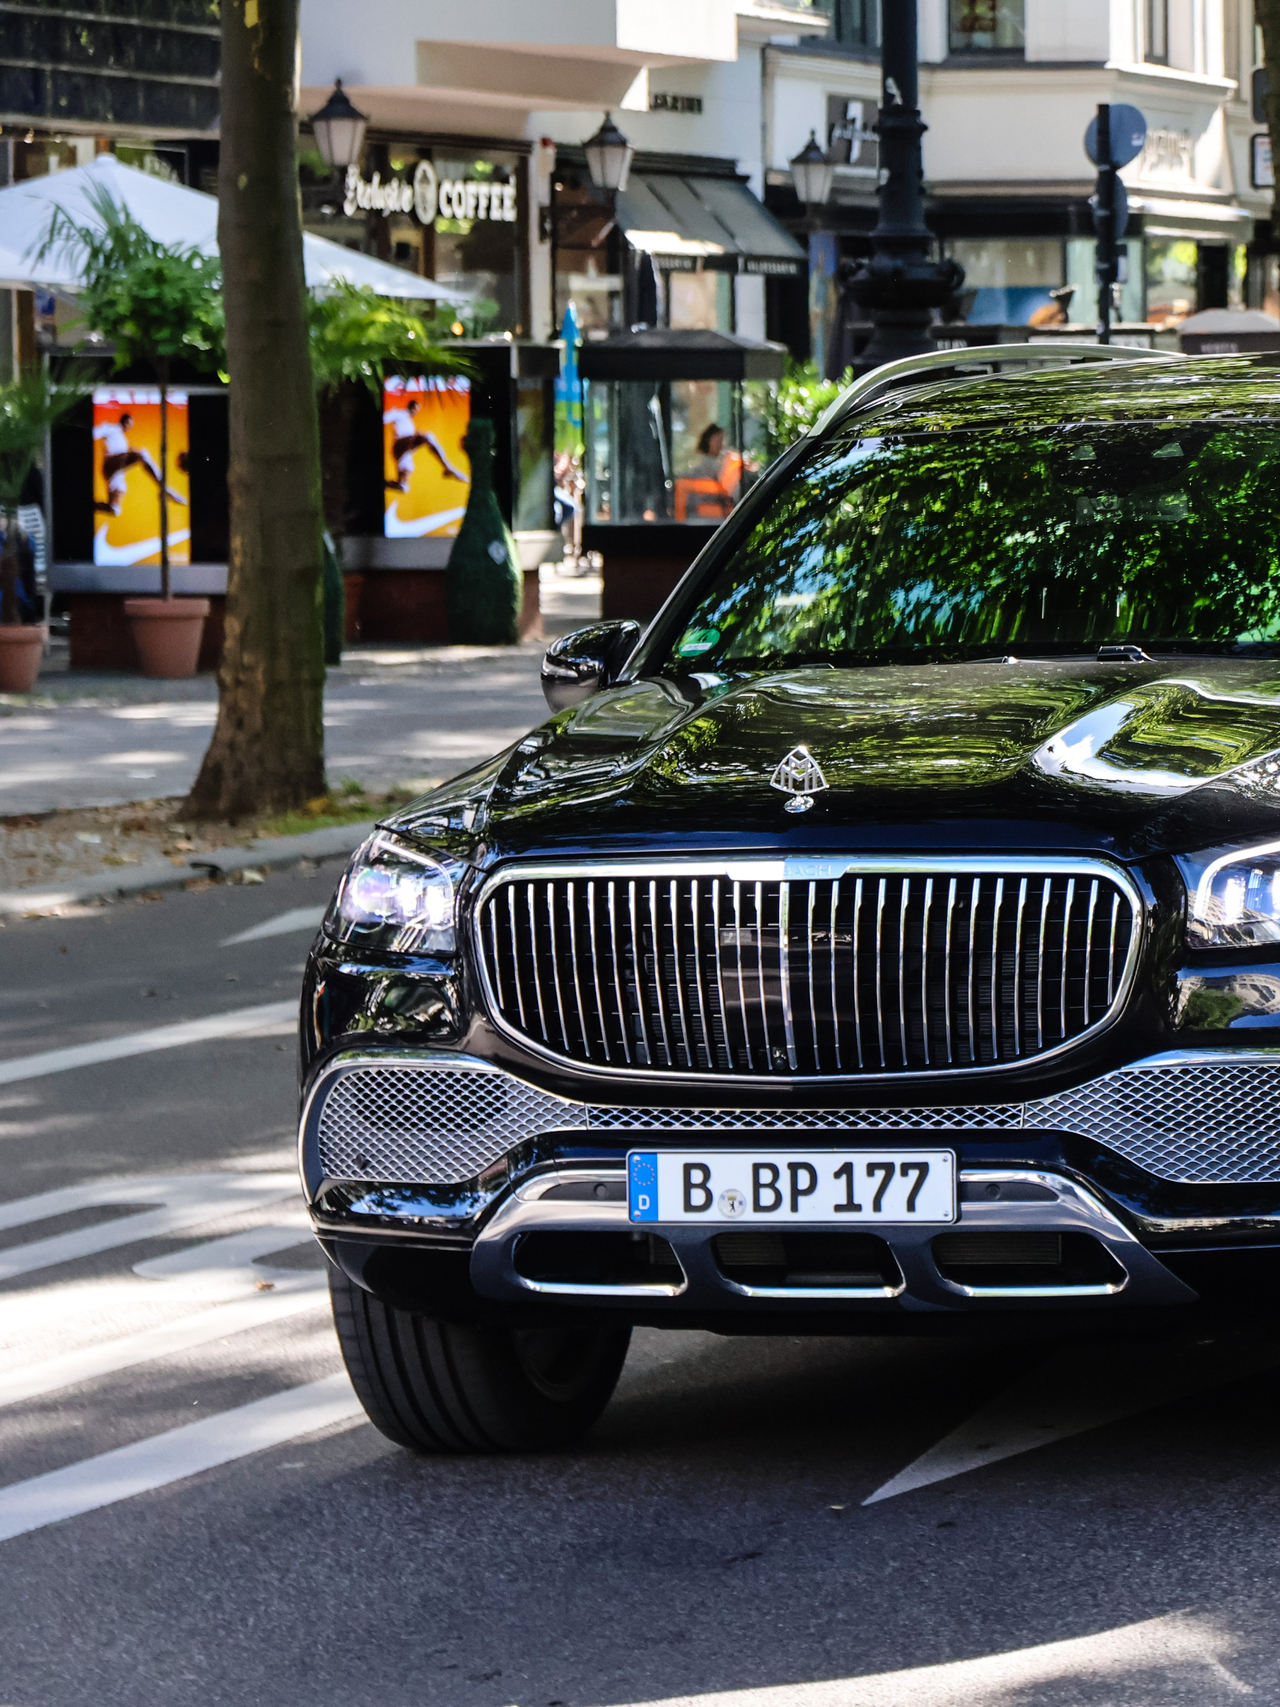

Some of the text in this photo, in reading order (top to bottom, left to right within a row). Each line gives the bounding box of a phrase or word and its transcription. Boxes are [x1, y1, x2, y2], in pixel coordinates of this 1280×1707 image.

[439, 176, 517, 222] COFFEE
[638, 1195, 650, 1210] D
[683, 1161, 930, 1213] B BP 177
